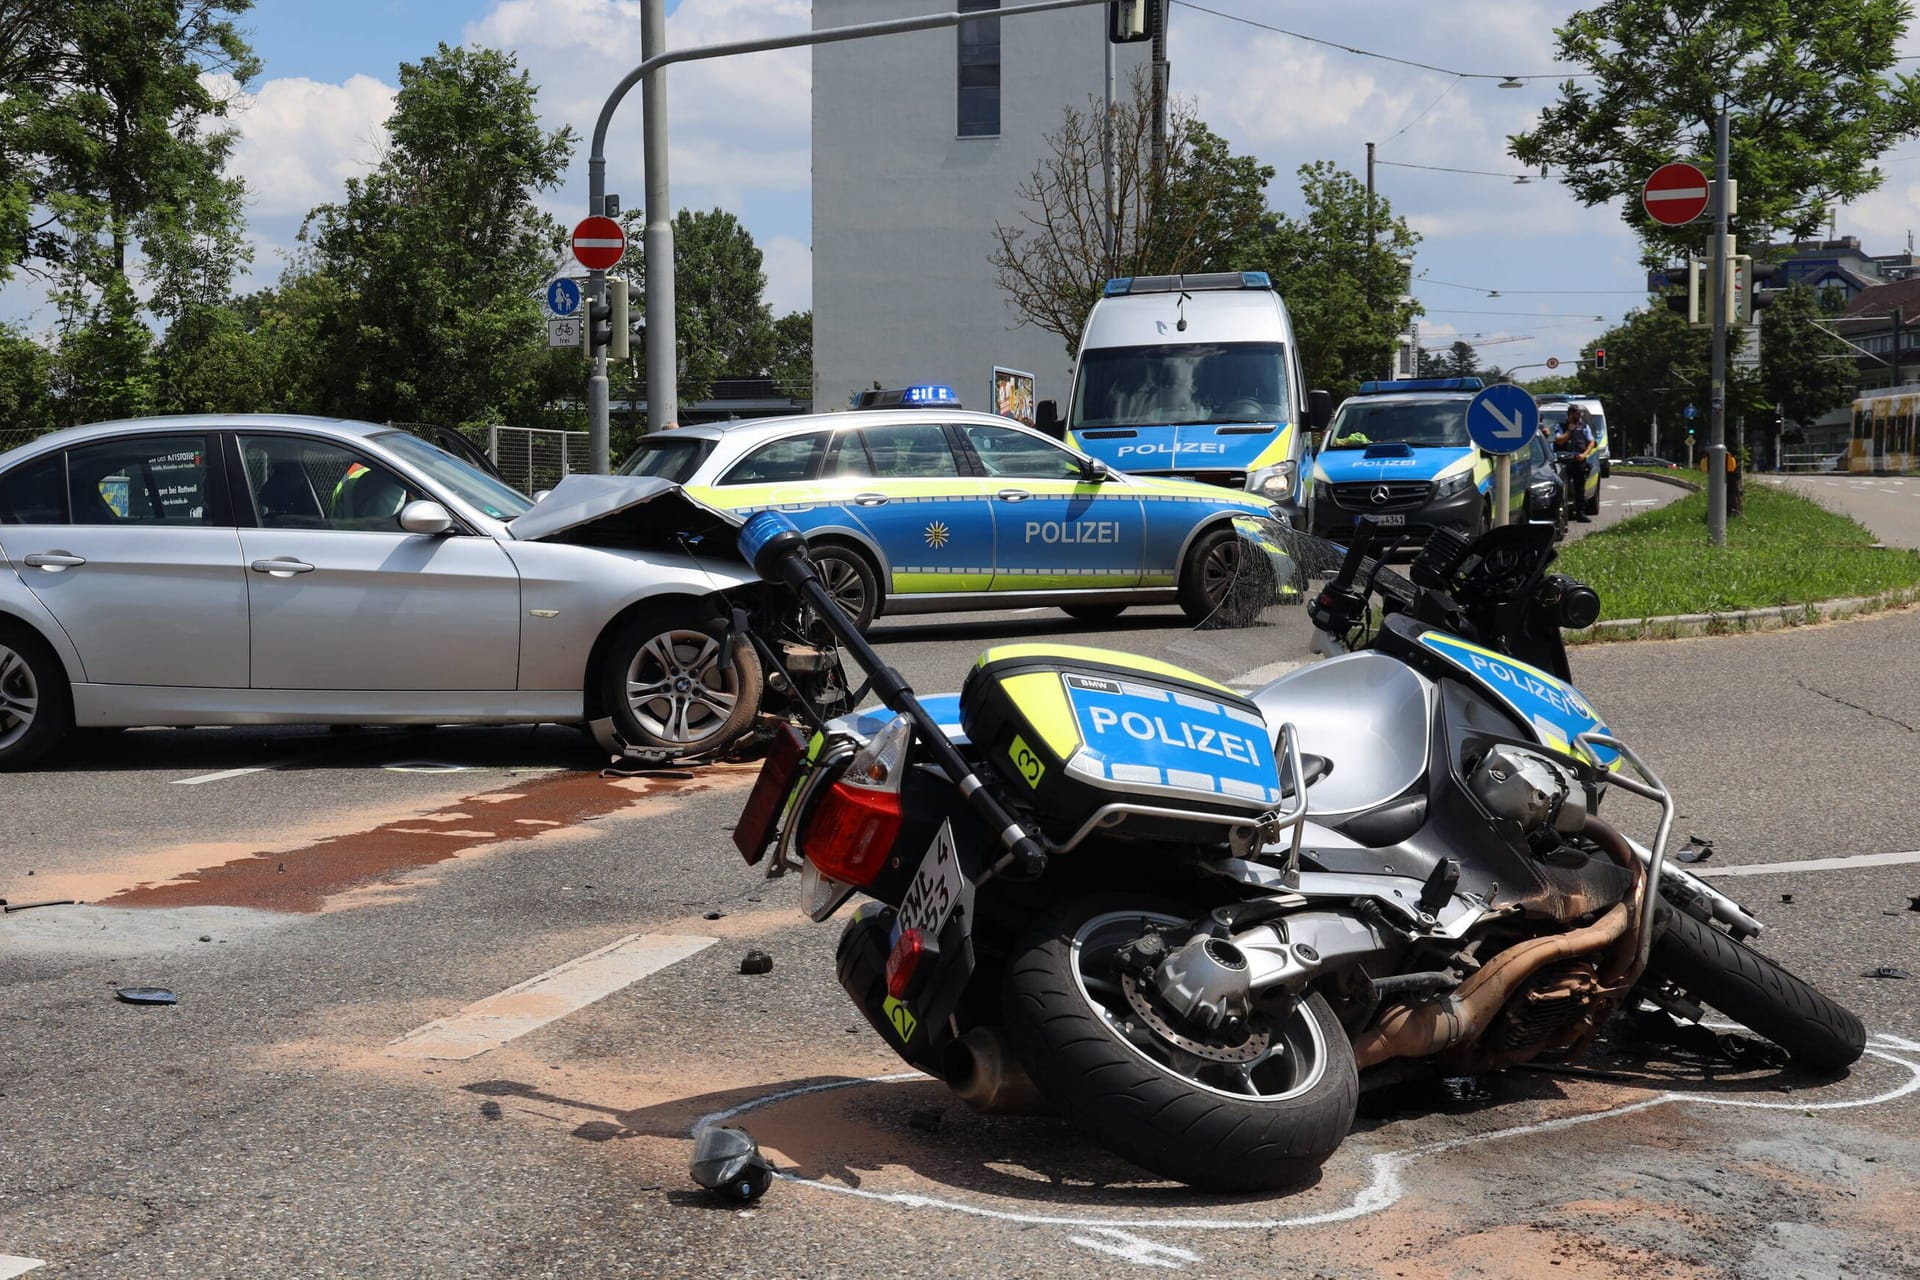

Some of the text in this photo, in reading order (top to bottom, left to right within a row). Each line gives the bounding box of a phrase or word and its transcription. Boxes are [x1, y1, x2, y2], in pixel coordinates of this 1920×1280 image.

[1117, 443, 1225, 457] POLIZEI
[1352, 459, 1416, 468] POLIZEI
[1025, 522, 1119, 543] POLIZEI
[1081, 679, 1107, 689] BMW
[1469, 653, 1571, 716] POLIZEI
[1089, 705, 1261, 767] POLIZEI
[1018, 749, 1039, 780] 3
[938, 834, 948, 866] 4
[892, 1004, 914, 1037] 2
